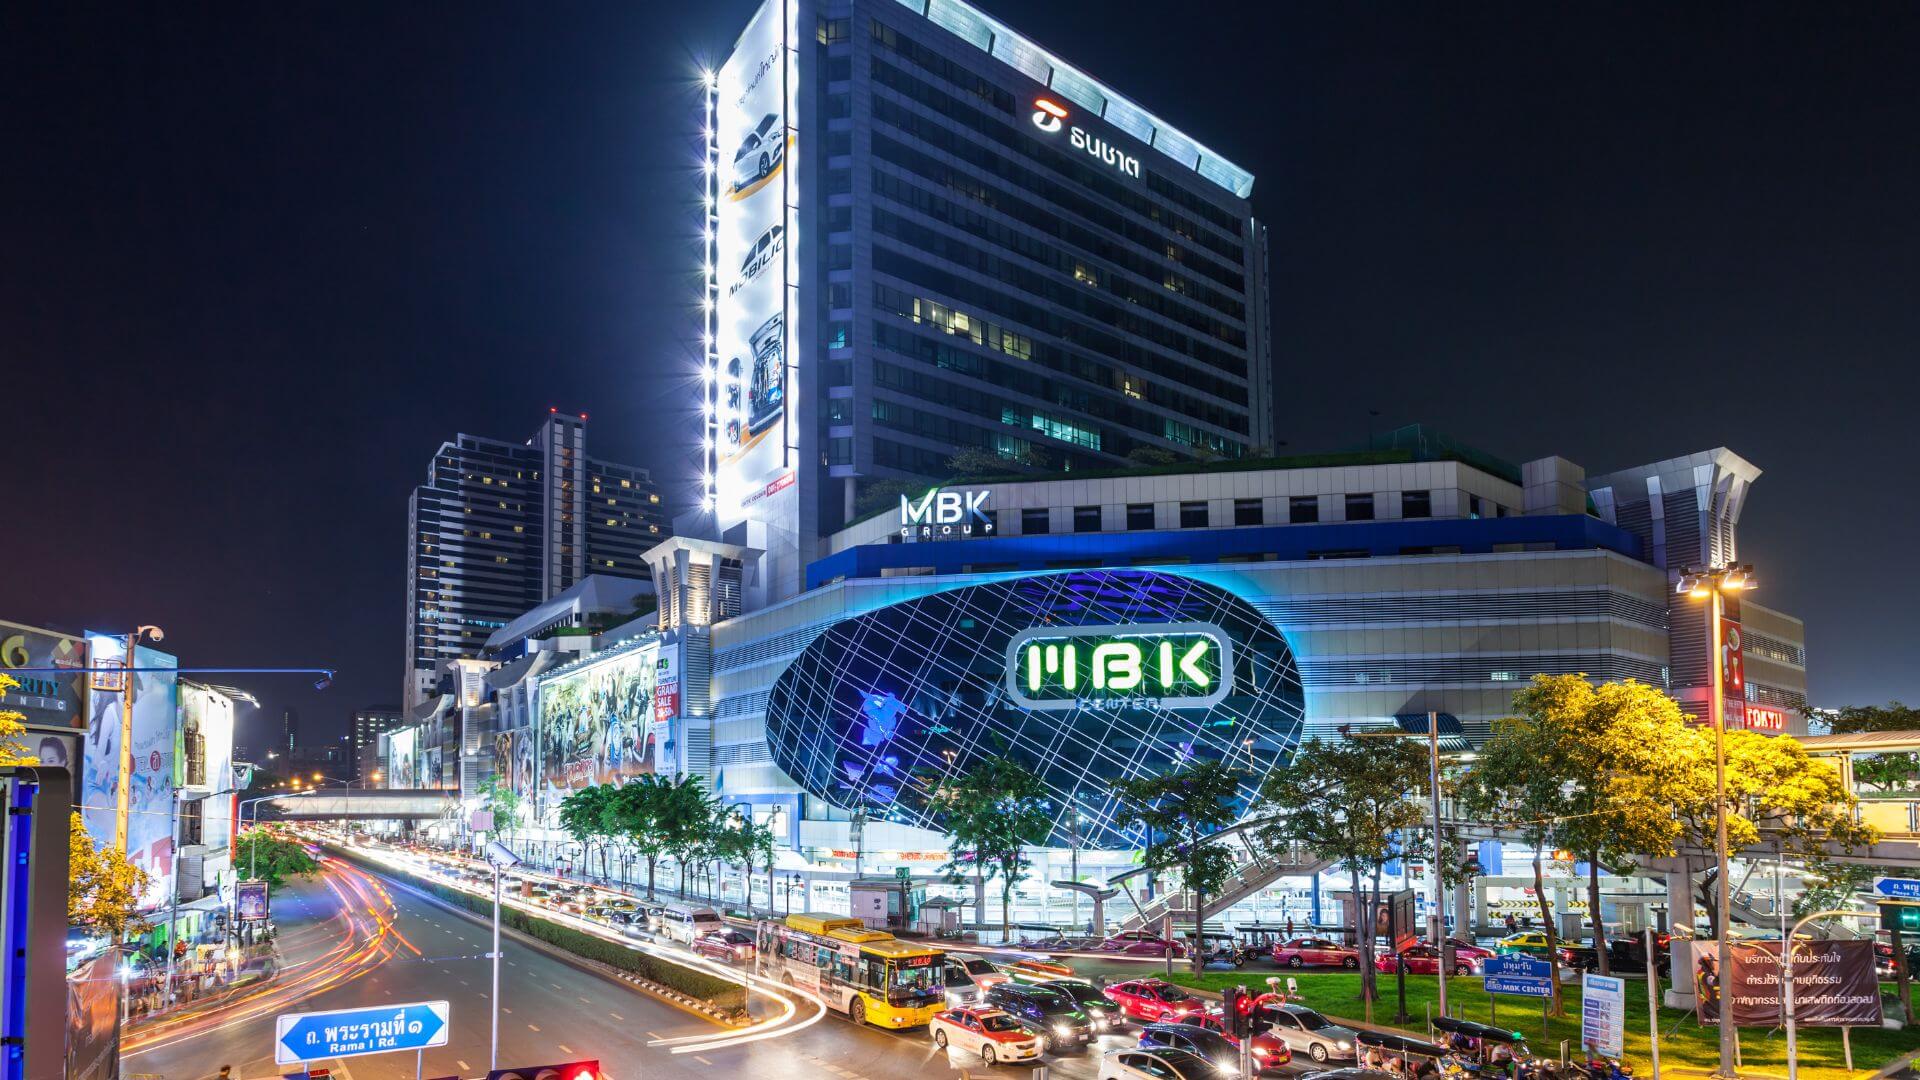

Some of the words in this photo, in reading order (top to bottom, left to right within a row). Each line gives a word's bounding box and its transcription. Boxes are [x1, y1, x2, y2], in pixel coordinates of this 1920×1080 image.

[1070, 126, 1139, 179] ธนชาต
[901, 487, 992, 525] MBK
[901, 523, 993, 537] GROUP
[1027, 639, 1210, 692] MBK
[657, 683, 678, 696] GRAND
[657, 696, 671, 706] SALE
[1746, 708, 1783, 730] TOKYU
[1503, 984, 1520, 992] MBK
[1521, 985, 1550, 994] CENTER
[306, 1031, 320, 1045] ถ.
[324, 1009, 406, 1043] พระรามที่
[408, 1020, 423, 1035] ๑
[330, 1042, 365, 1053] Rama
[378, 1038, 398, 1048] Rd.
